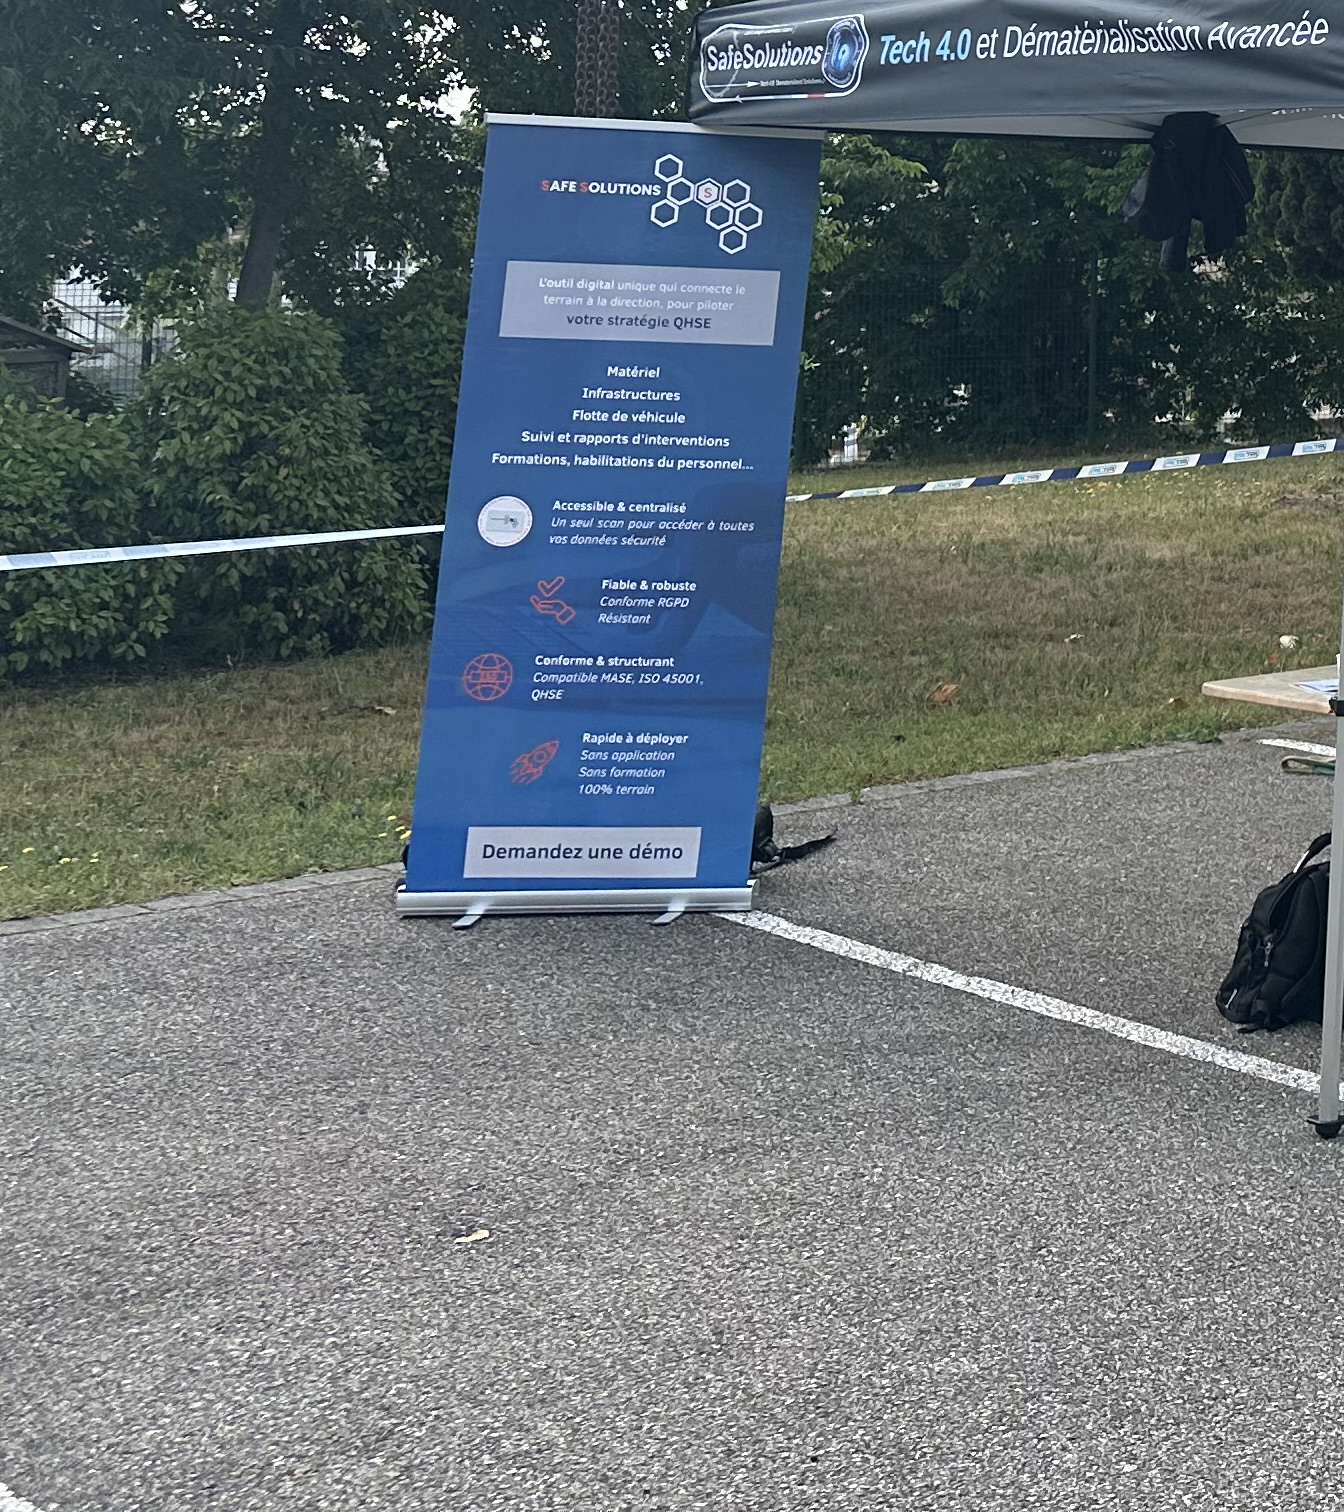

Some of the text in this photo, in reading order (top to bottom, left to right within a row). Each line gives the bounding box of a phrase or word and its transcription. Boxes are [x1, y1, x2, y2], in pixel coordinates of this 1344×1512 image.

[879, 9, 1330, 65] Tech 4.0 et Dématérialisation Avancée
[706, 40, 825, 72] SafeSolutions
[541, 180, 662, 196] SAFE SOLUTIONS
[577, 278, 615, 292] digital
[617, 280, 656, 292] unique
[659, 281, 678, 294] qui
[680, 283, 733, 295] connecte
[735, 284, 746, 295] le
[543, 294, 734, 312] terrain à la direction, pour piloter
[566, 314, 713, 330] votre stratégie QHSE
[606, 365, 661, 379] Matériel
[582, 387, 681, 401] Infrastructures
[572, 409, 686, 424] Flotte de véhicule
[521, 430, 731, 448] Suivi et rapports d'interventions
[491, 452, 754, 472] Formations, habilitations du personnel...
[552, 500, 687, 514] Accessible & centralisé
[551, 516, 755, 533] Un seul scan pour accéder à toutes
[549, 532, 667, 547] vos données sécurité
[601, 579, 697, 592] Fiable & robuste
[599, 595, 690, 609] Conforme RGPD
[597, 612, 652, 624] Résistant
[534, 655, 675, 668] Conforme & structurant
[532, 671, 705, 686] Compatible MASE, ISO 45001,
[530, 689, 564, 702] QHSE
[582, 731, 689, 746] Rapide à déployer
[580, 749, 676, 763] Sans application
[578, 766, 666, 779] Sans formation
[578, 783, 655, 795] 100% terrain
[482, 842, 684, 861] Demandez une démo
